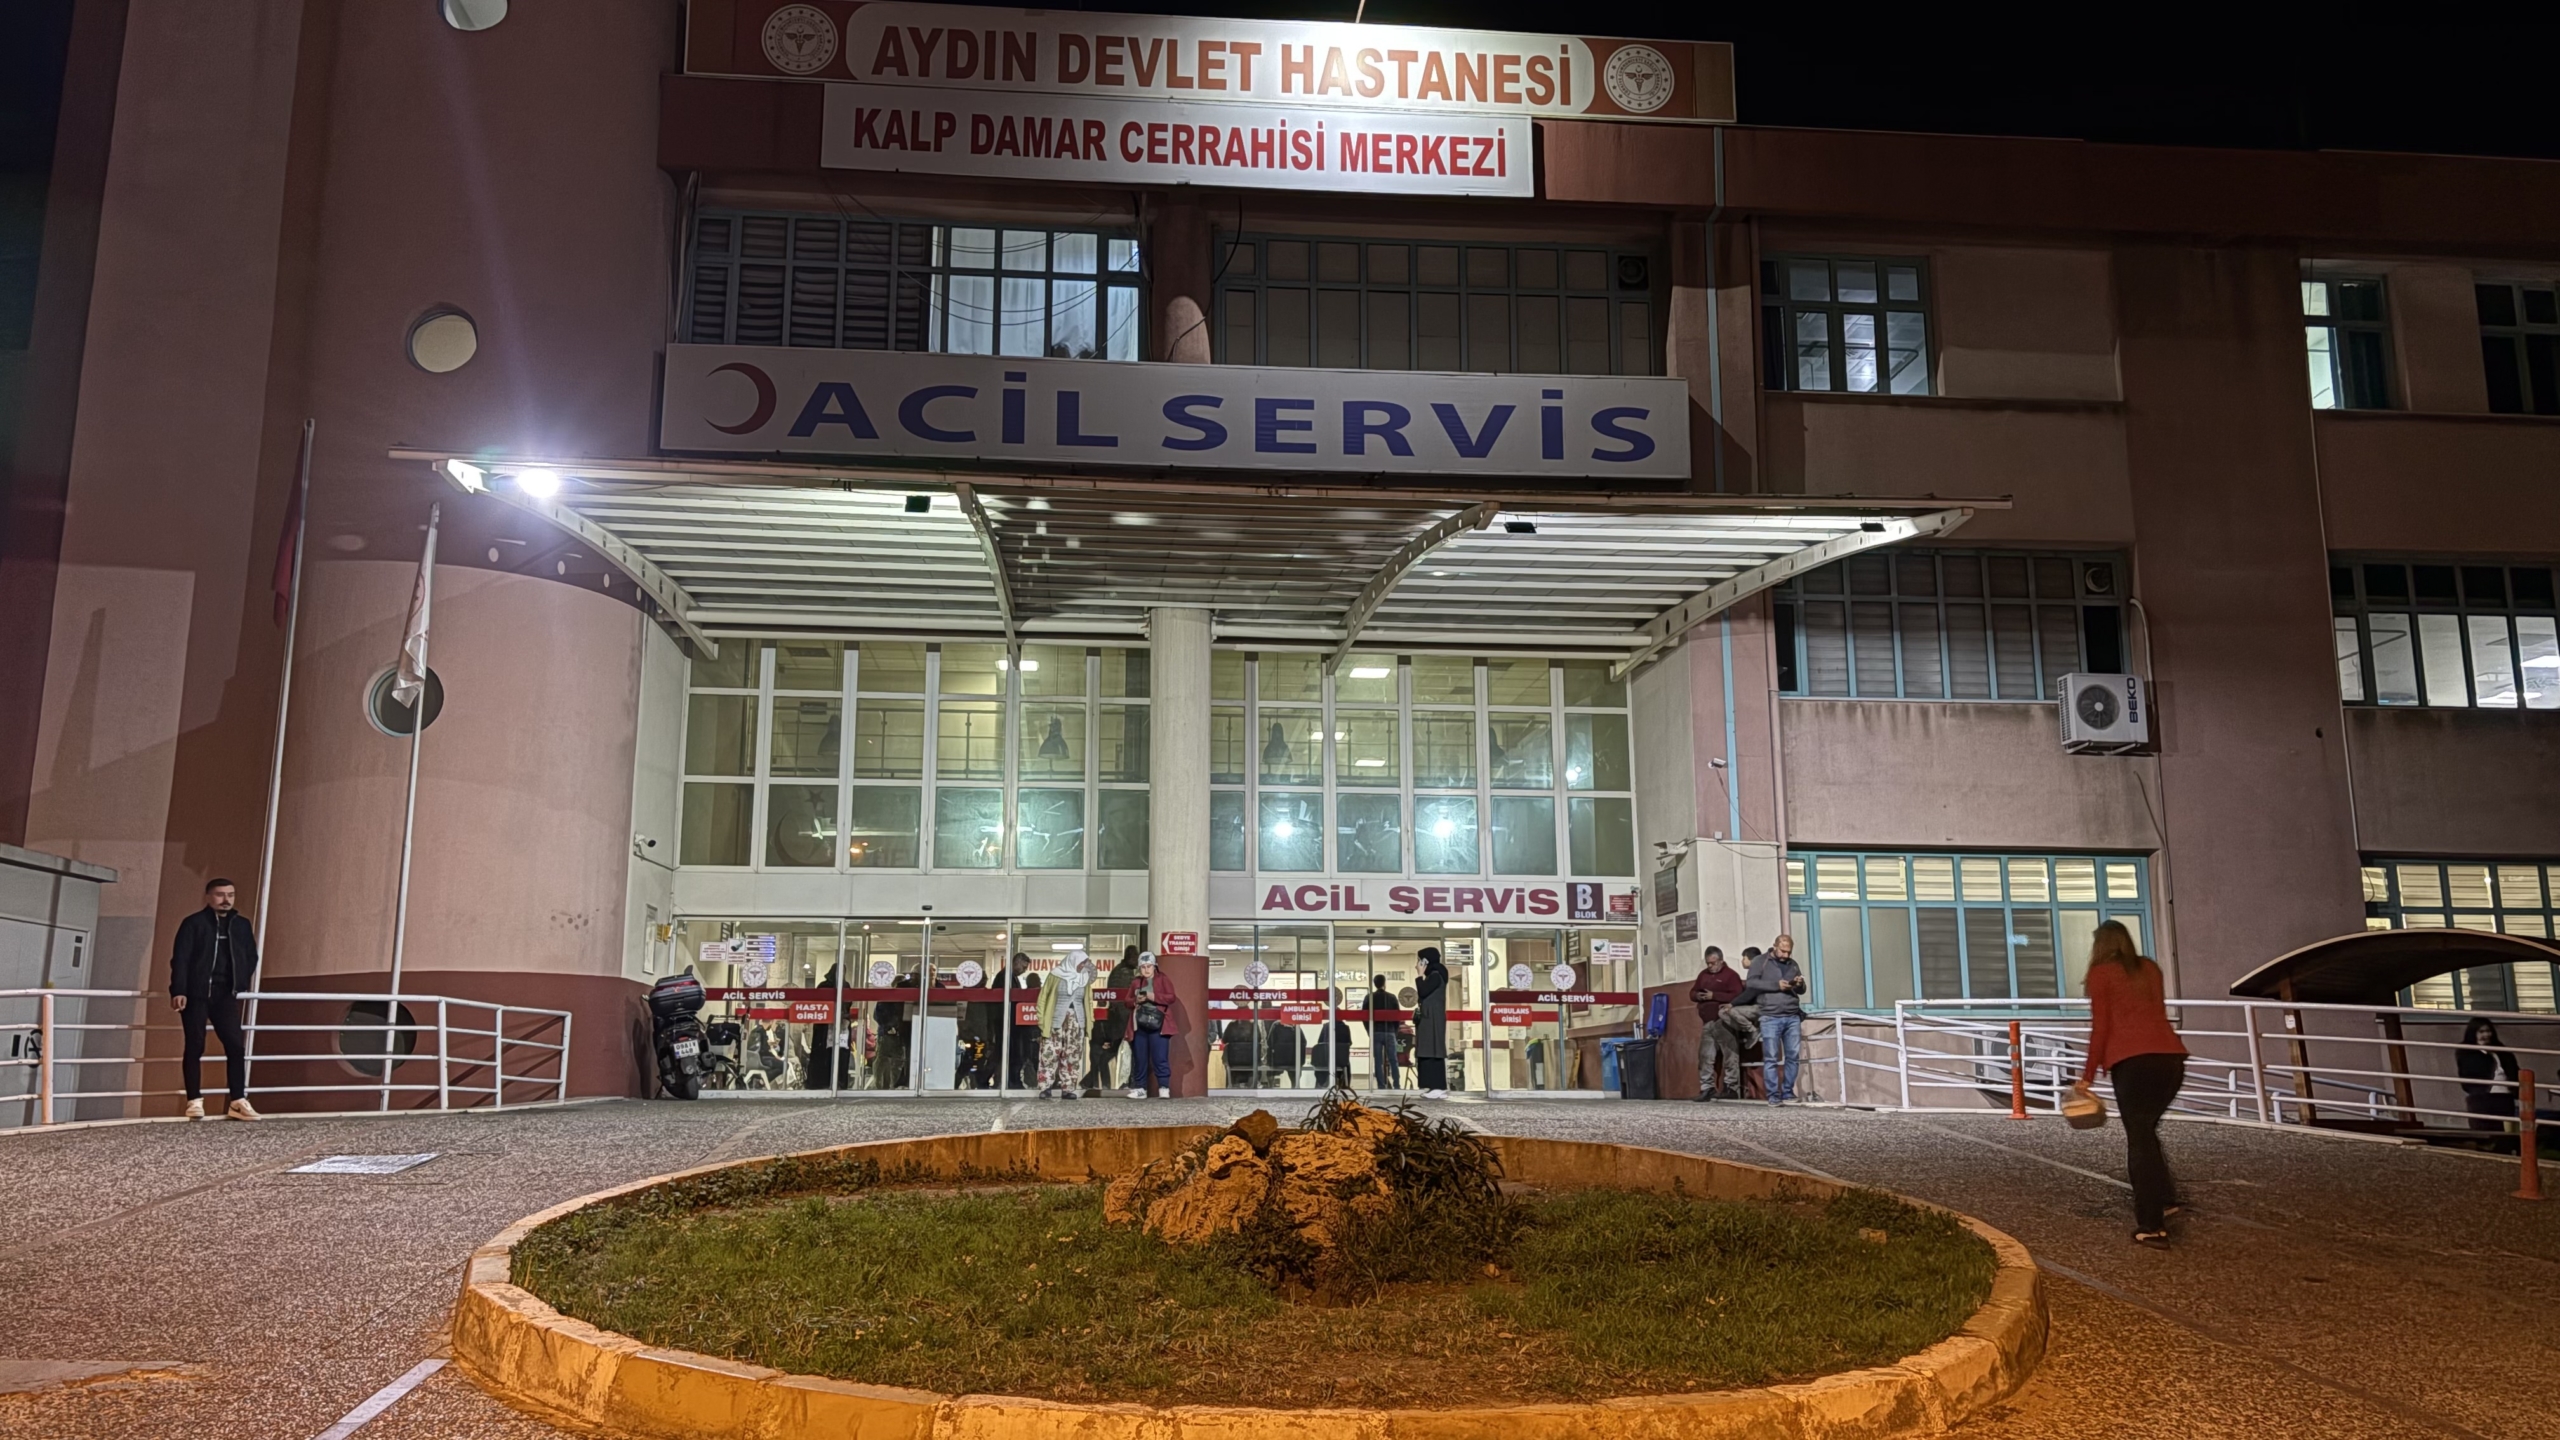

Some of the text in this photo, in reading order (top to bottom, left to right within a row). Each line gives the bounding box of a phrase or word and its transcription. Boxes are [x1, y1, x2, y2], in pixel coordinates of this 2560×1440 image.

[871, 25, 1038, 83] AYDIN
[1057, 33, 1262, 92] DEVLET
[1280, 43, 1572, 107] HASTANESİ
[853, 107, 1507, 178] KALP DAMAR CERRAHİSİ MERKEZİ
[787, 371, 1656, 463] ACİL SERVİS
[2126, 677, 2139, 724] BEKO
[1576, 883, 1594, 910] B
[1574, 910, 1598, 919] BLOK
[722, 990, 786, 1000] ACİL SERVİS
[1228, 991, 1288, 1000] ACİL SERVİS
[1537, 993, 1596, 1003] ACİL SERVİS
[795, 1003, 829, 1012] HASTA
[796, 1011, 828, 1021] GİRİŞİ
[1291, 1012, 1312, 1021] GİRİŞİ
[1501, 1014, 1522, 1023] GİRİŞİ
